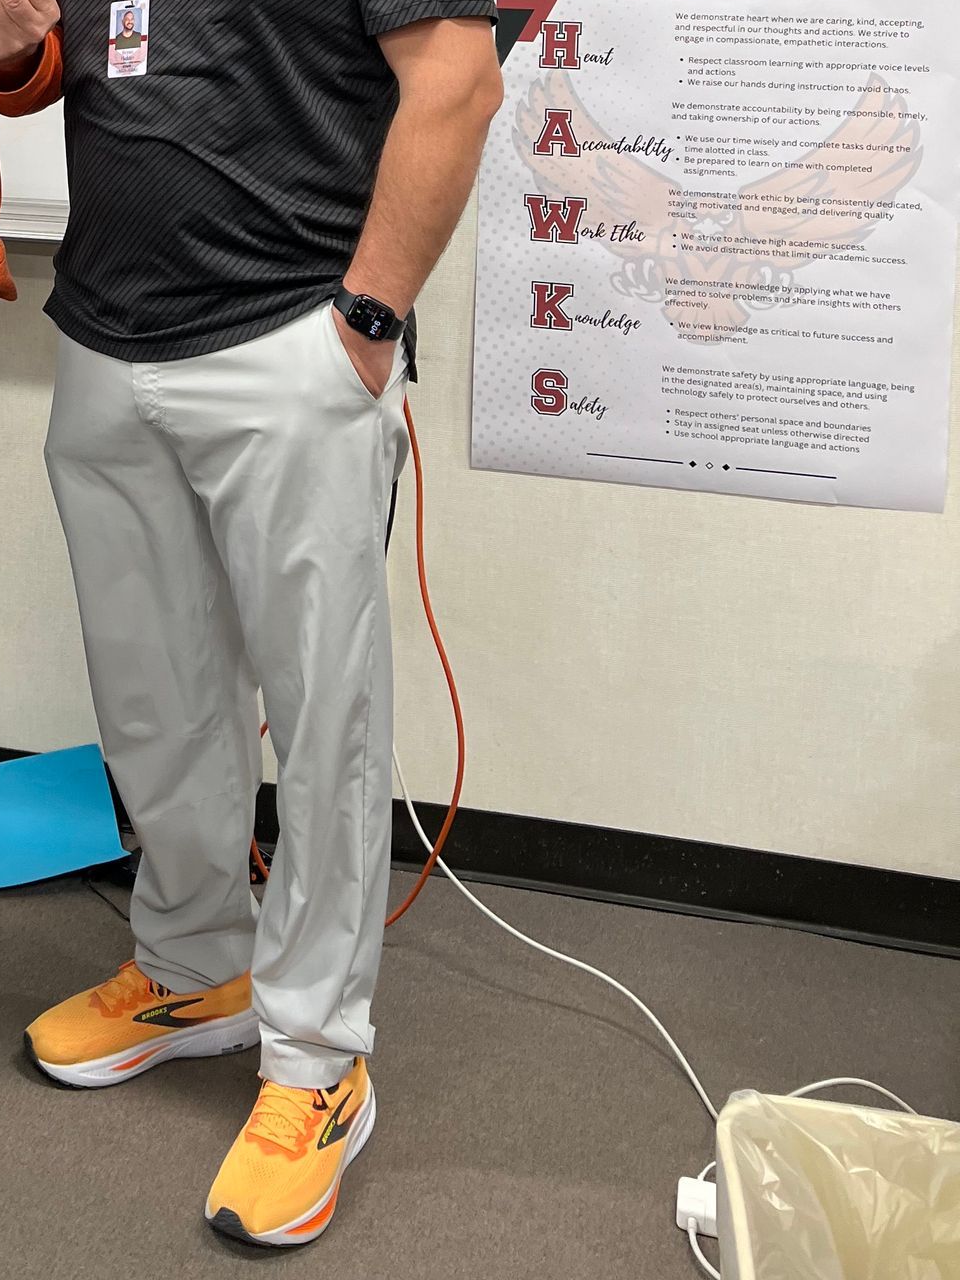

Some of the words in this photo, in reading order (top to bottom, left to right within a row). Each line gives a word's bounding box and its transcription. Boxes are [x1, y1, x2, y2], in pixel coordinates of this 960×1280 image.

[675, 13, 688, 21] We
[691, 14, 744, 22] demonstrate
[747, 14, 769, 23] heart
[771, 16, 794, 24] when
[857, 18, 877, 27] kind,
[688, 56, 722, 66] Respect
[724, 58, 767, 67] classroom
[769, 60, 803, 69] learning
[805, 61, 824, 69] with
[826, 62, 876, 72] appropriate
[905, 64, 930, 73] levels
[610, 221, 645, 242] Ethic
[674, 429, 689, 437] Use
[691, 430, 718, 440] school
[720, 434, 769, 445] appropriate
[772, 439, 809, 450] language
[811, 442, 827, 450] and
[829, 443, 860, 453] actions
[141, 1007, 168, 1021] BROOKS
